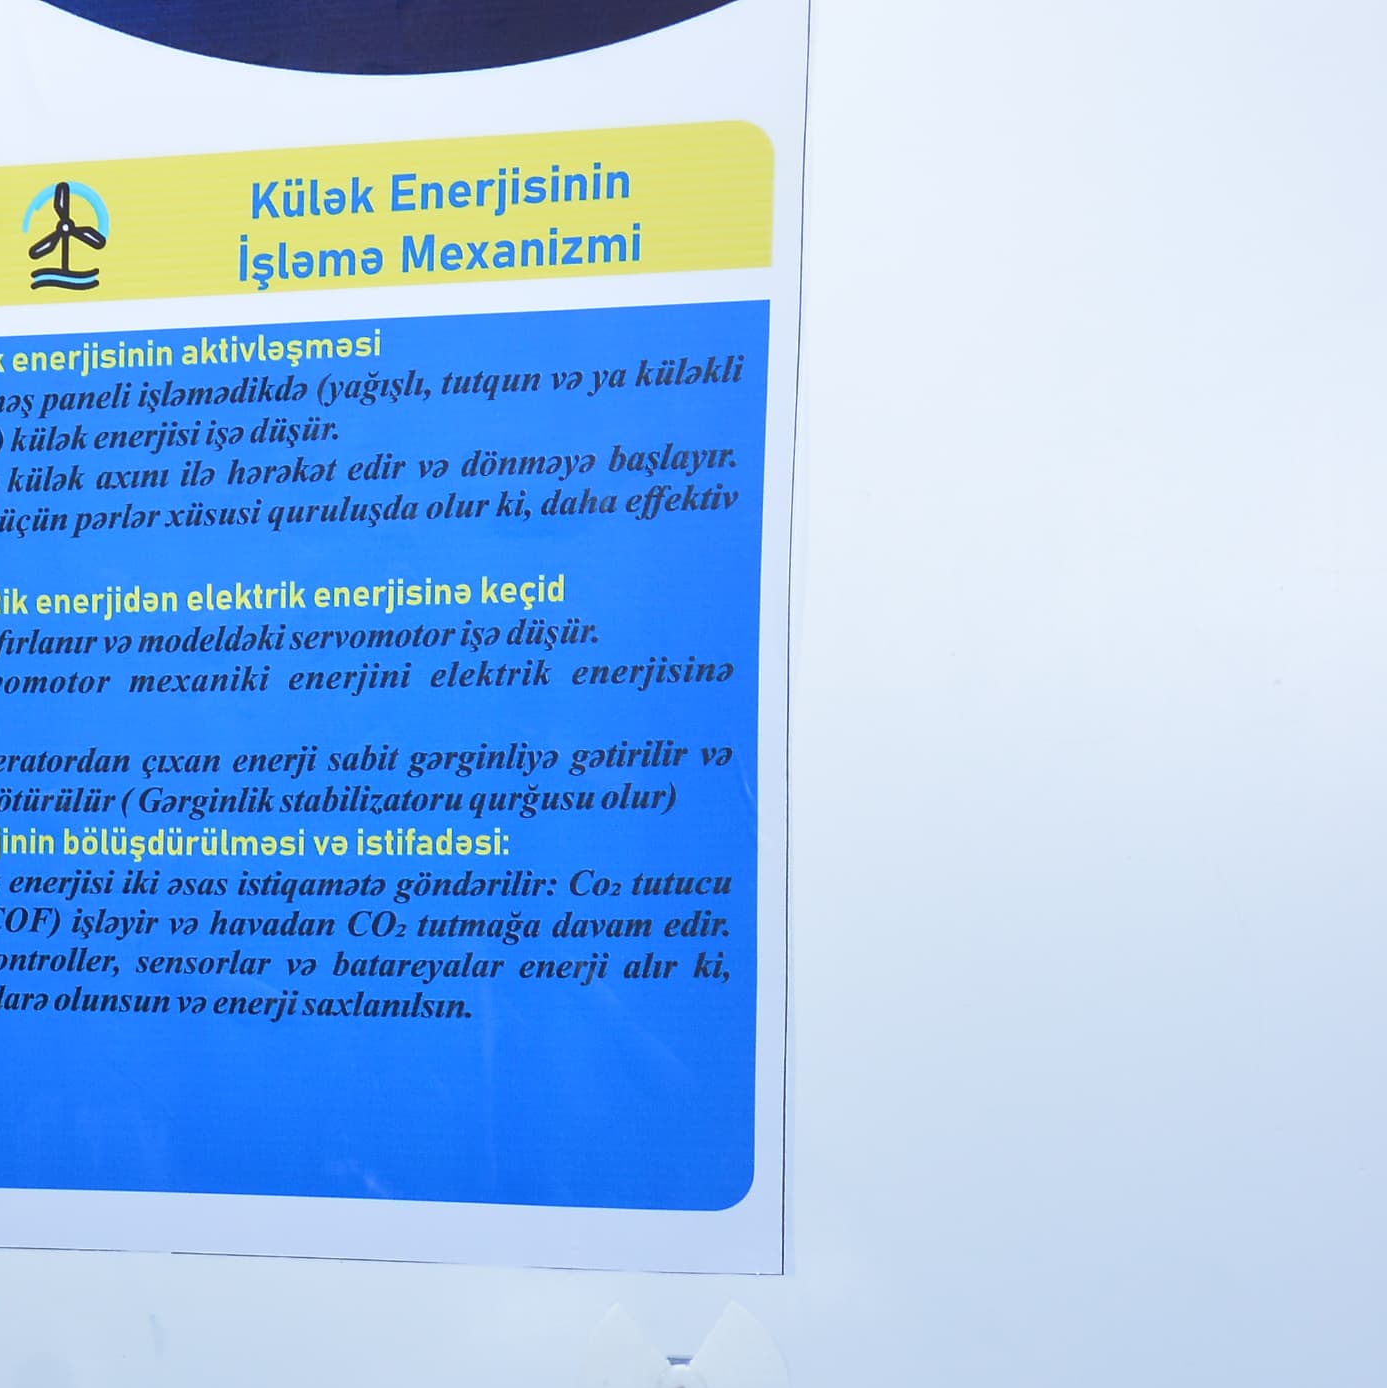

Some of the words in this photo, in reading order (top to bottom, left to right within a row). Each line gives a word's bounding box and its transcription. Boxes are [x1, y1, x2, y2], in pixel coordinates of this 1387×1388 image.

[252, 177, 374, 219] Külək
[392, 162, 630, 212] Enerjisinin
[240, 234, 384, 291] İşləmə
[403, 222, 641, 273] Mexanizmi
[13, 339, 173, 375] enerjisinin
[182, 328, 381, 368] aktivləşməsi
[39, 382, 131, 418] paneli
[138, 375, 307, 414] işləmədikdə
[317, 369, 431, 407] (yağışlı,
[442, 370, 540, 401] tutqun
[552, 371, 583, 390] və
[587, 369, 626, 396] ya
[635, 355, 744, 387] küləkli
[37, 585, 178, 620] enerjidən
[188, 581, 305, 611] elektrik
[315, 578, 471, 613] enerjisinə
[482, 574, 565, 611] keçid
[64, 827, 305, 863] bölüşdürülməsi
[314, 835, 348, 856] və
[358, 827, 509, 856] istifadəsi:
[9, 870, 114, 901] enerjisi
[123, 869, 160, 895] iki
[167, 878, 227, 895] əsas
[238, 871, 386, 903] istiqamətə
[394, 870, 557, 903] göndərilir:
[632, 873, 731, 896] tutucu
